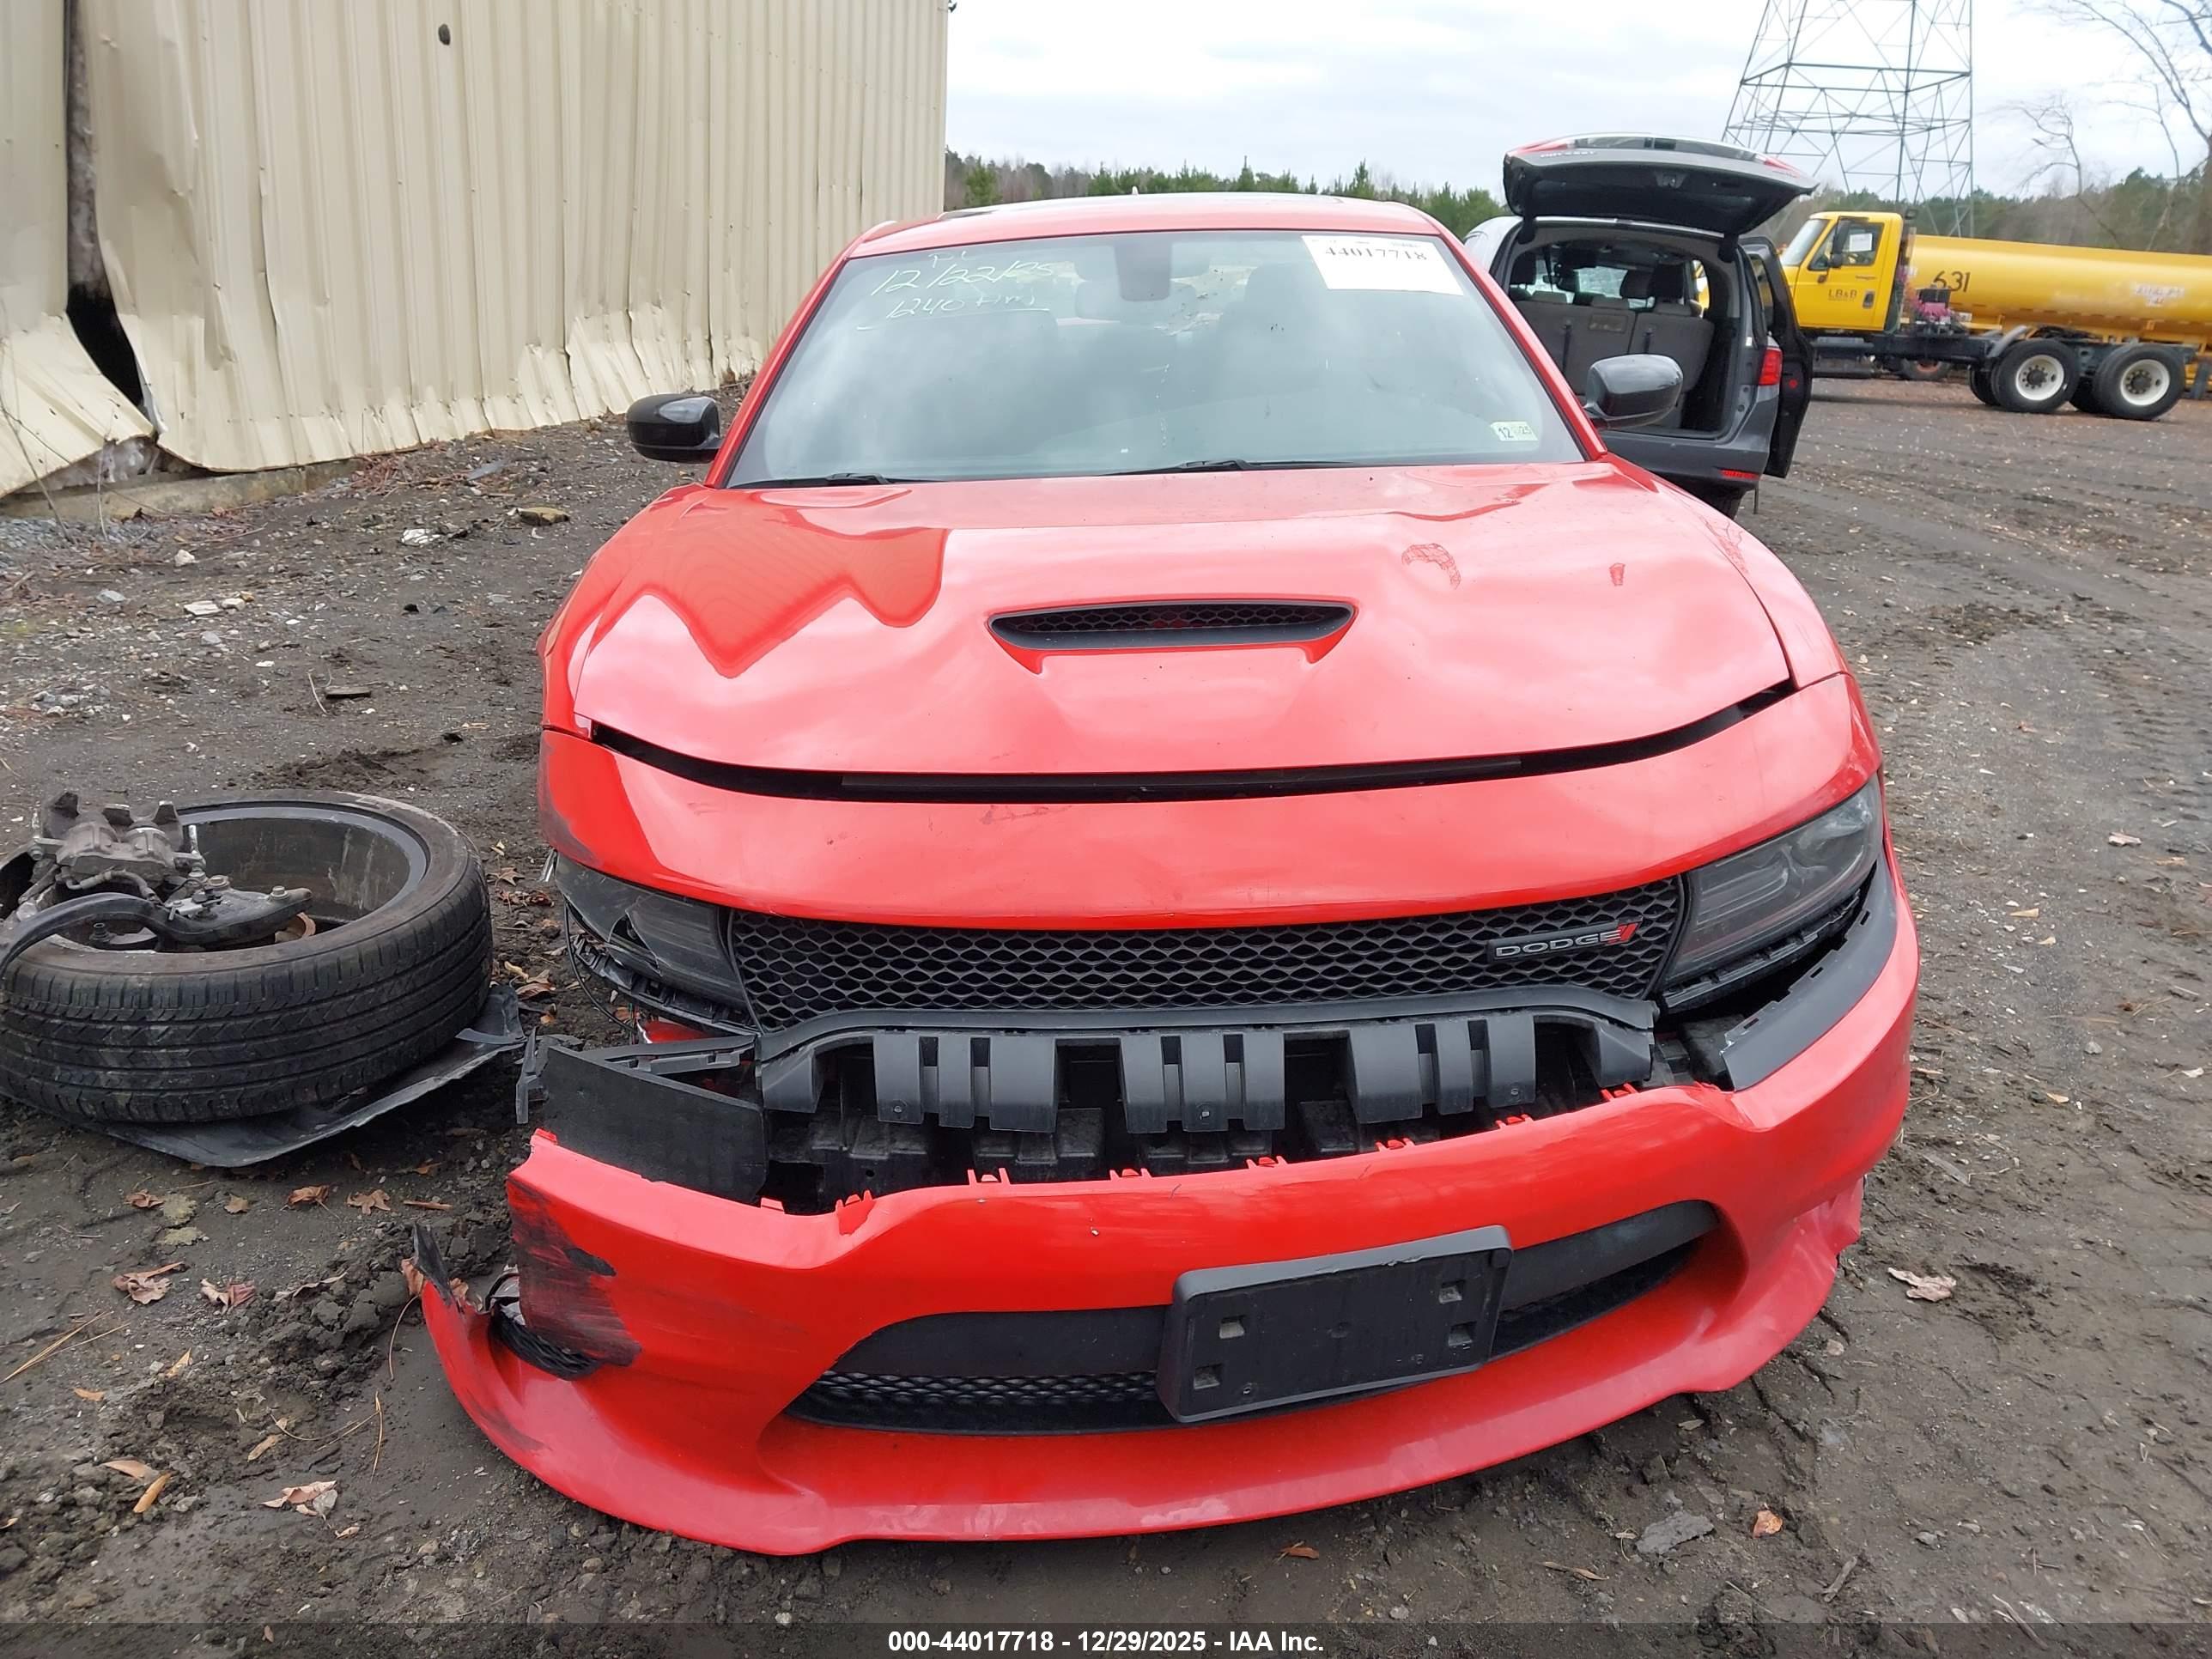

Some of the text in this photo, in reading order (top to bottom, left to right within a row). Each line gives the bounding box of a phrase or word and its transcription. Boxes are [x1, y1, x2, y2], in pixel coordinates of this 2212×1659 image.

[1325, 246, 1428, 261] 44017718
[1933, 270, 1971, 293] 631
[1498, 427, 1514, 439] 12
[1496, 929, 1622, 957] DODGE
